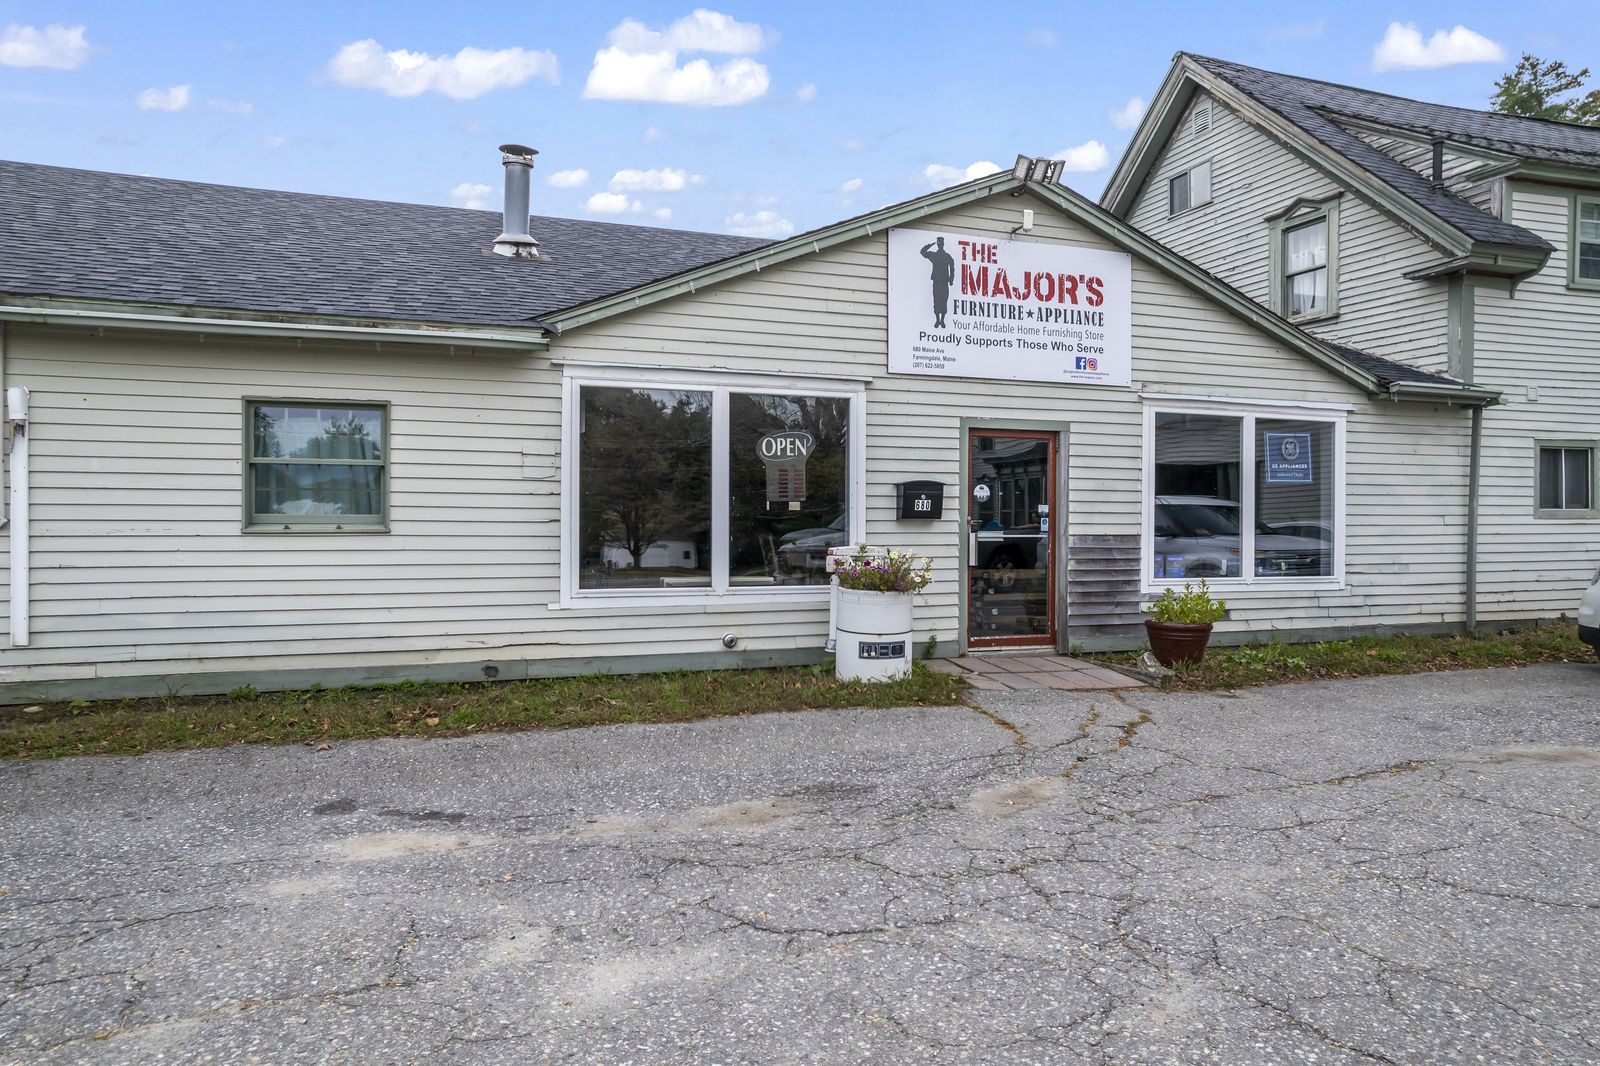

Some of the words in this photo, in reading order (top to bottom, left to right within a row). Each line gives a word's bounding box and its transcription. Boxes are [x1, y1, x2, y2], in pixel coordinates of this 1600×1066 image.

[958, 240, 998, 264] THE
[961, 264, 1104, 307] MAJOR'S
[953, 299, 1024, 321] FURNITURE
[1036, 307, 1104, 327] APPLIANCE
[953, 319, 971, 330] Your
[973, 320, 1015, 334] Affordable
[1017, 325, 1040, 335] Home
[1043, 326, 1083, 341] Furnishing
[1085, 330, 1104, 341] Store
[919, 331, 962, 346] Proudly
[965, 334, 1013, 348] Supports
[1016, 338, 1048, 350] Those
[1051, 341, 1074, 352] Who
[1076, 343, 1104, 354] Serve
[762, 437, 807, 456] OPEN
[915, 500, 931, 510] 680
